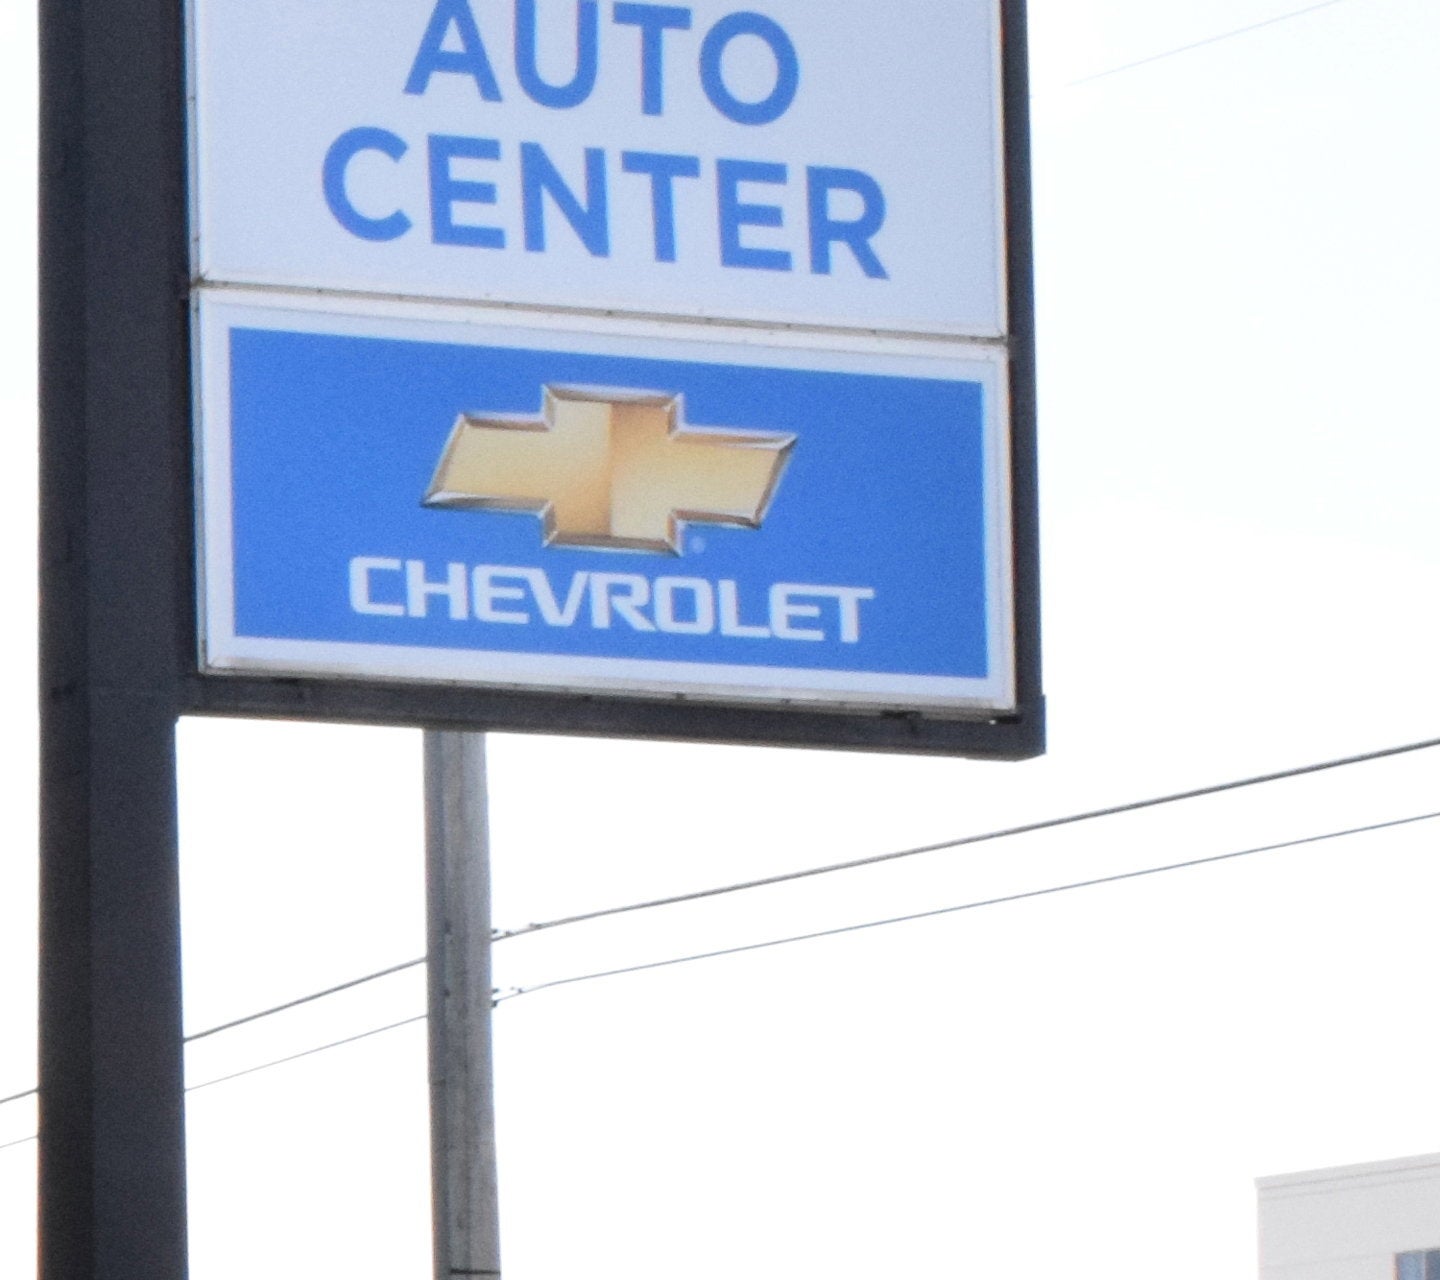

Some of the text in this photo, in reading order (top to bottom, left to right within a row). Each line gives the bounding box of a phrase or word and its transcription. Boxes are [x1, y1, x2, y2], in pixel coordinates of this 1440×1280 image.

[403, 0, 801, 127] AUTO
[321, 125, 890, 281] CENTER
[347, 555, 876, 644] CHEVROLET
